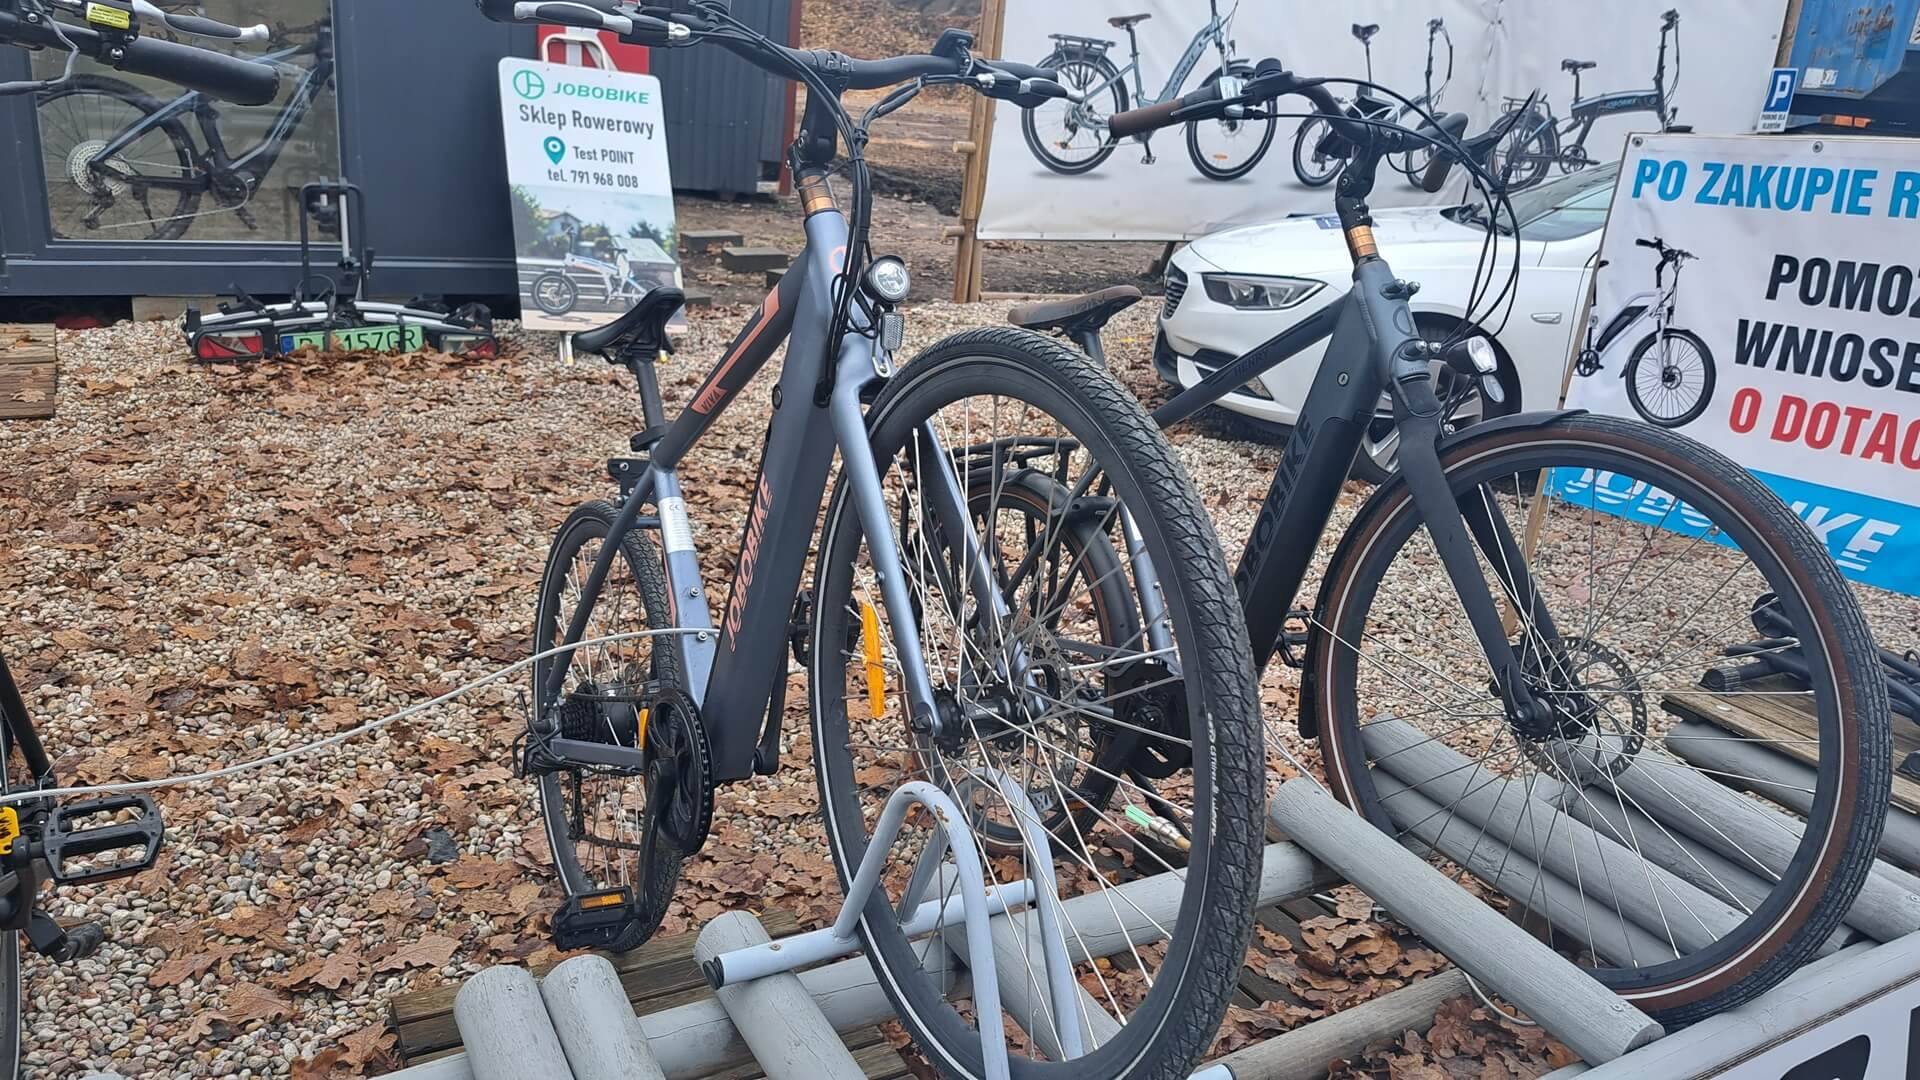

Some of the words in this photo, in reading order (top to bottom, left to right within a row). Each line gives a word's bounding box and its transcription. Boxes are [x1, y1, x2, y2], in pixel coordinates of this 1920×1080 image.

[553, 82, 650, 104] JOBOBIKE
[519, 104, 567, 131] Sklep
[572, 110, 655, 140] Rowerowy
[573, 146, 598, 161] Test
[601, 149, 634, 165] POINT
[548, 169, 568, 182] tel.
[570, 170, 591, 185] 791
[593, 172, 614, 186] 968
[617, 174, 639, 188] 008
[1632, 159, 1688, 202] PO
[1695, 162, 1878, 216] ZAKUPIE
[1729, 387, 1762, 434] O
[726, 471, 773, 652] JOBOBIKE
